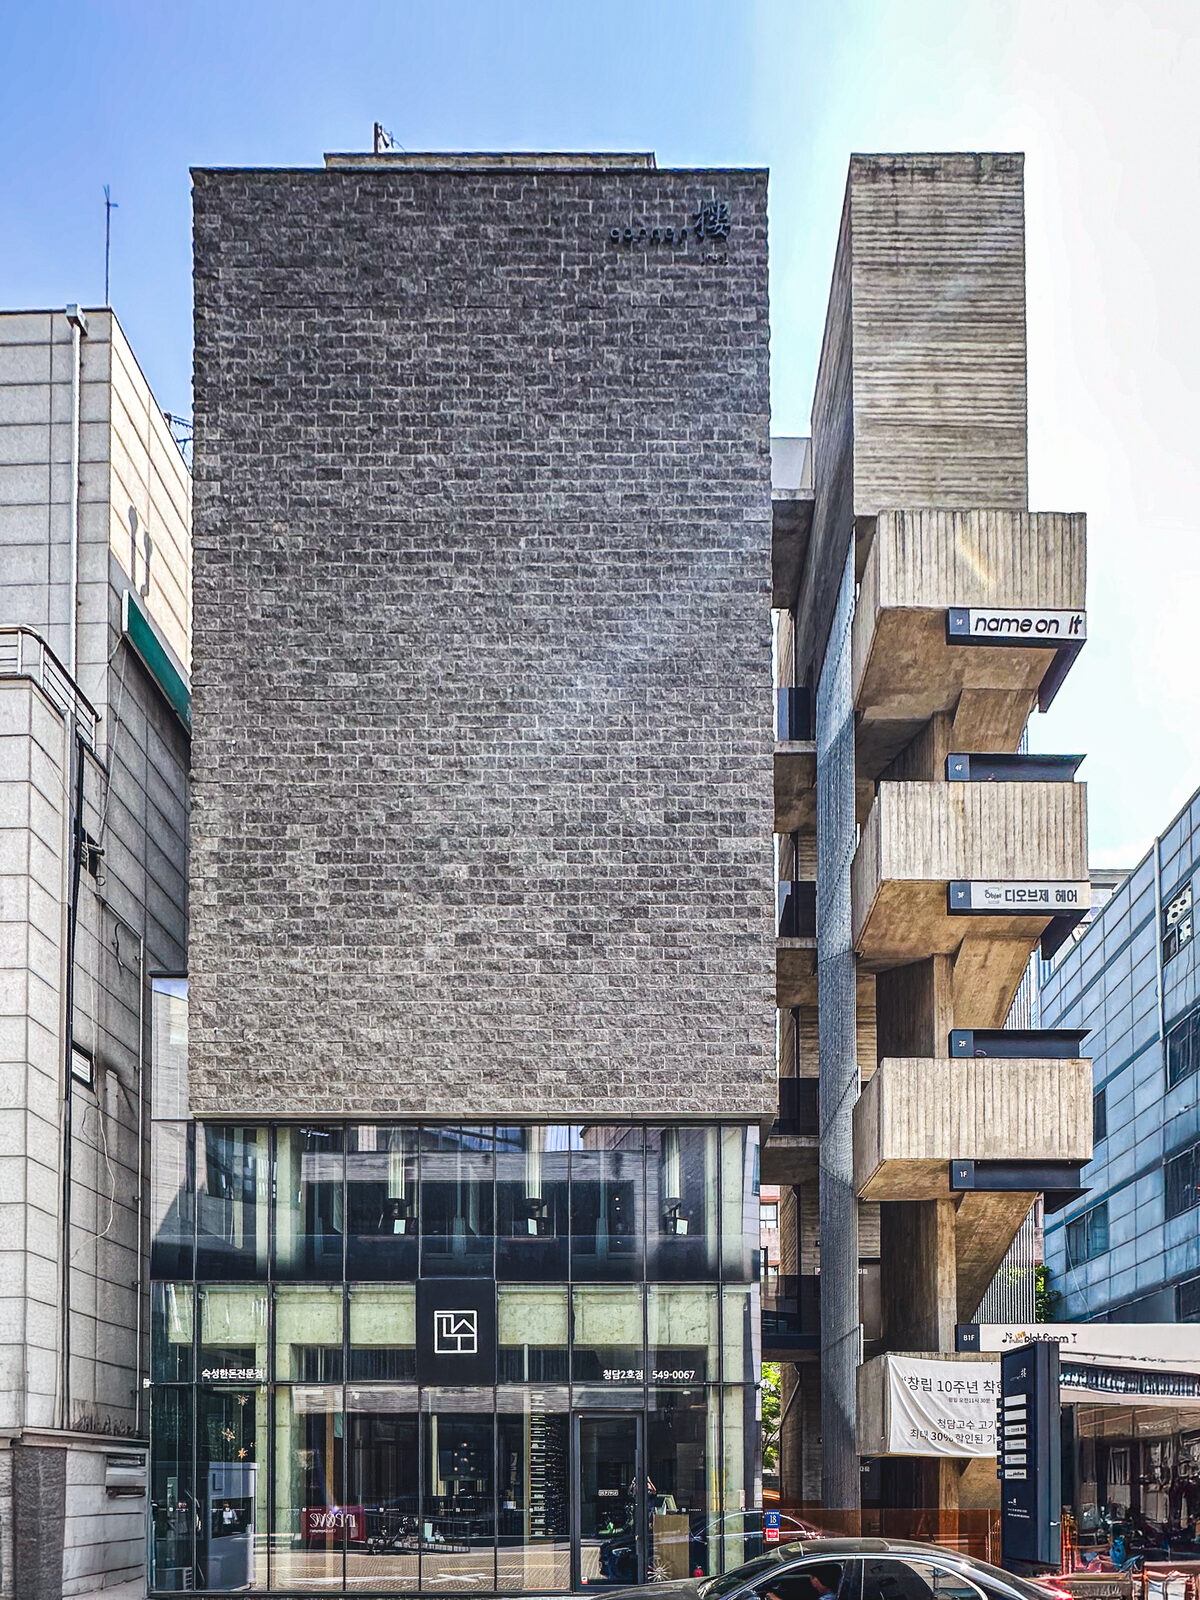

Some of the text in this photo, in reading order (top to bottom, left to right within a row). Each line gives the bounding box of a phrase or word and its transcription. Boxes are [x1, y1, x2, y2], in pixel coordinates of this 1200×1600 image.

[974, 617, 1033, 633] name
[1035, 618, 1060, 634] on
[1004, 889, 1078, 903] 디오브제 헤어
[959, 1170, 968, 1178] 1F
[1024, 1333, 1069, 1344] platform
[201, 1368, 264, 1379] 숙성한돈전문점
[602, 1369, 644, 1380] 청담2호점
[652, 1370, 695, 1379] 549-0067
[937, 1380, 978, 1395] 10주년
[937, 1419, 975, 1430] 청담고수
[930, 1432, 954, 1442] 30%
[955, 1433, 983, 1445] 할인된
[769, 1514, 777, 1523] 18
